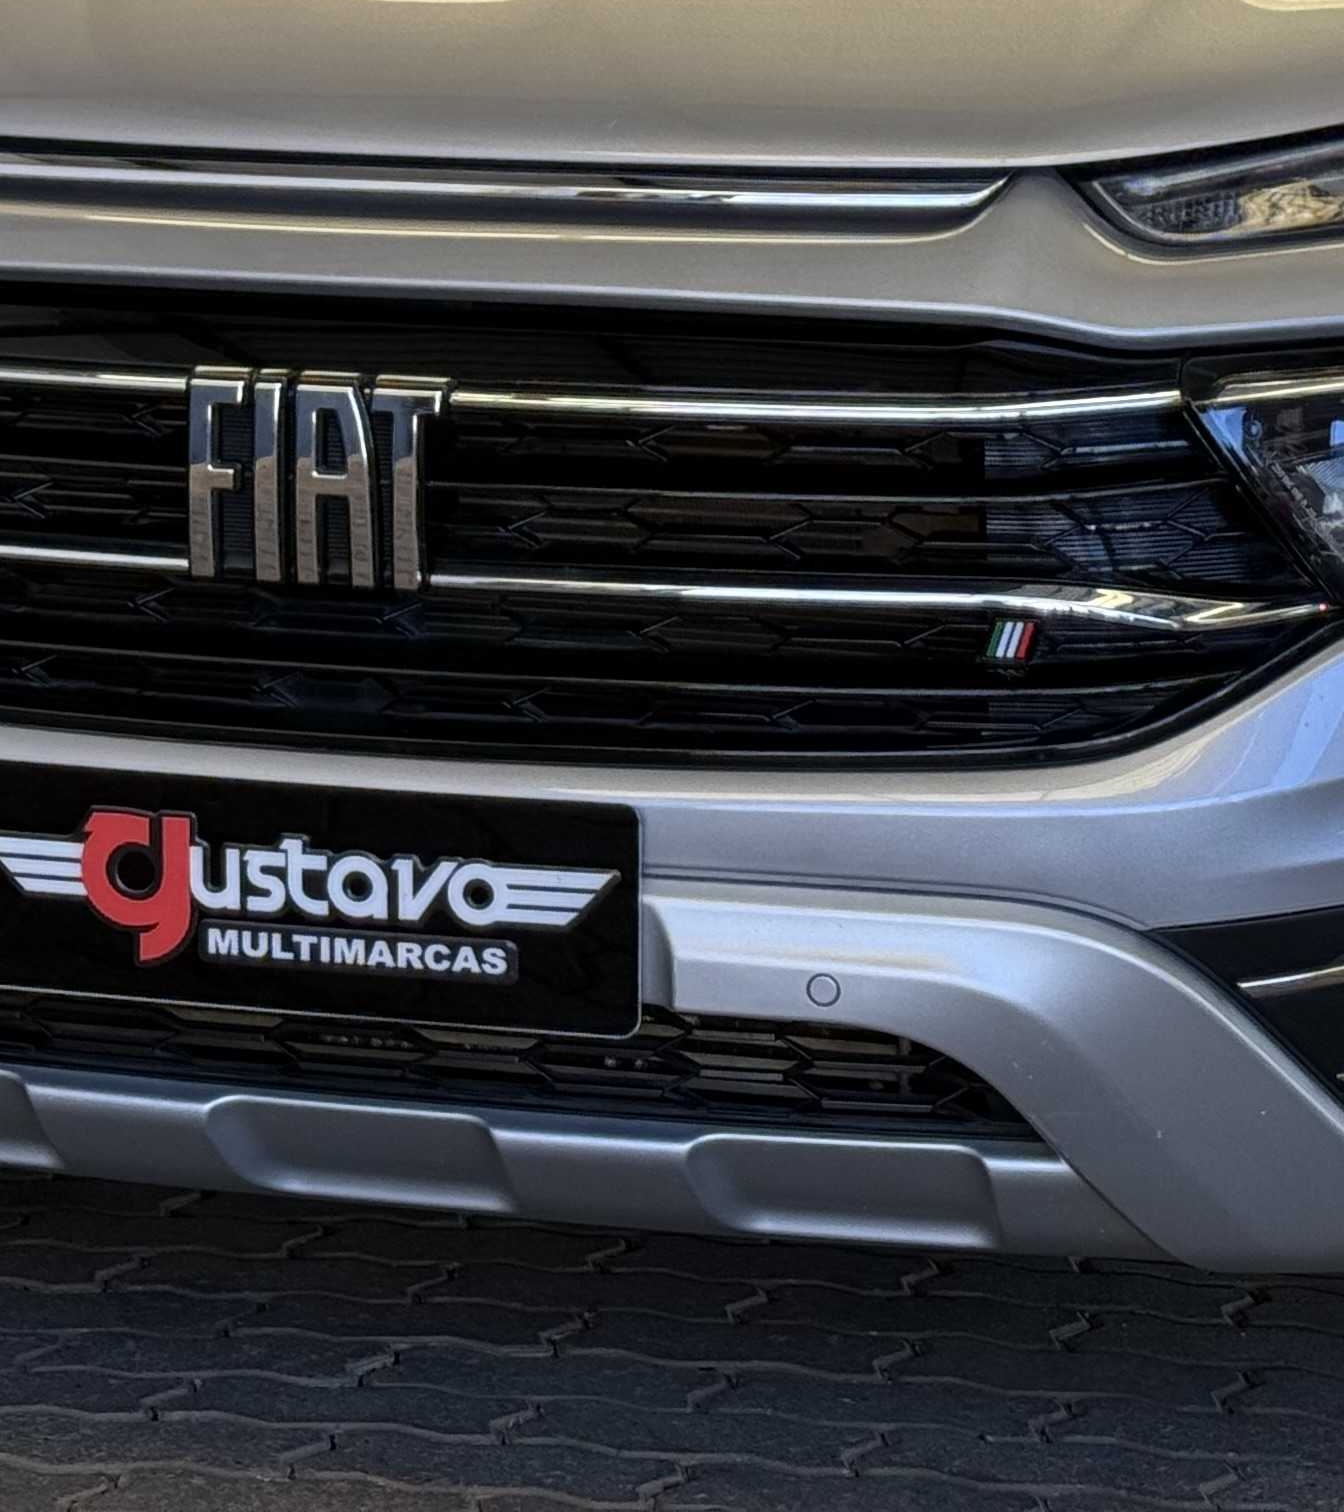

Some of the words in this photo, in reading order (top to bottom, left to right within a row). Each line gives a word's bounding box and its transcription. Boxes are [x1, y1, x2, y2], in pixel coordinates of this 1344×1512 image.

[188, 367, 446, 589] FIAT
[79, 806, 509, 964] gustavo
[205, 926, 510, 977] MULTIMARCAS
